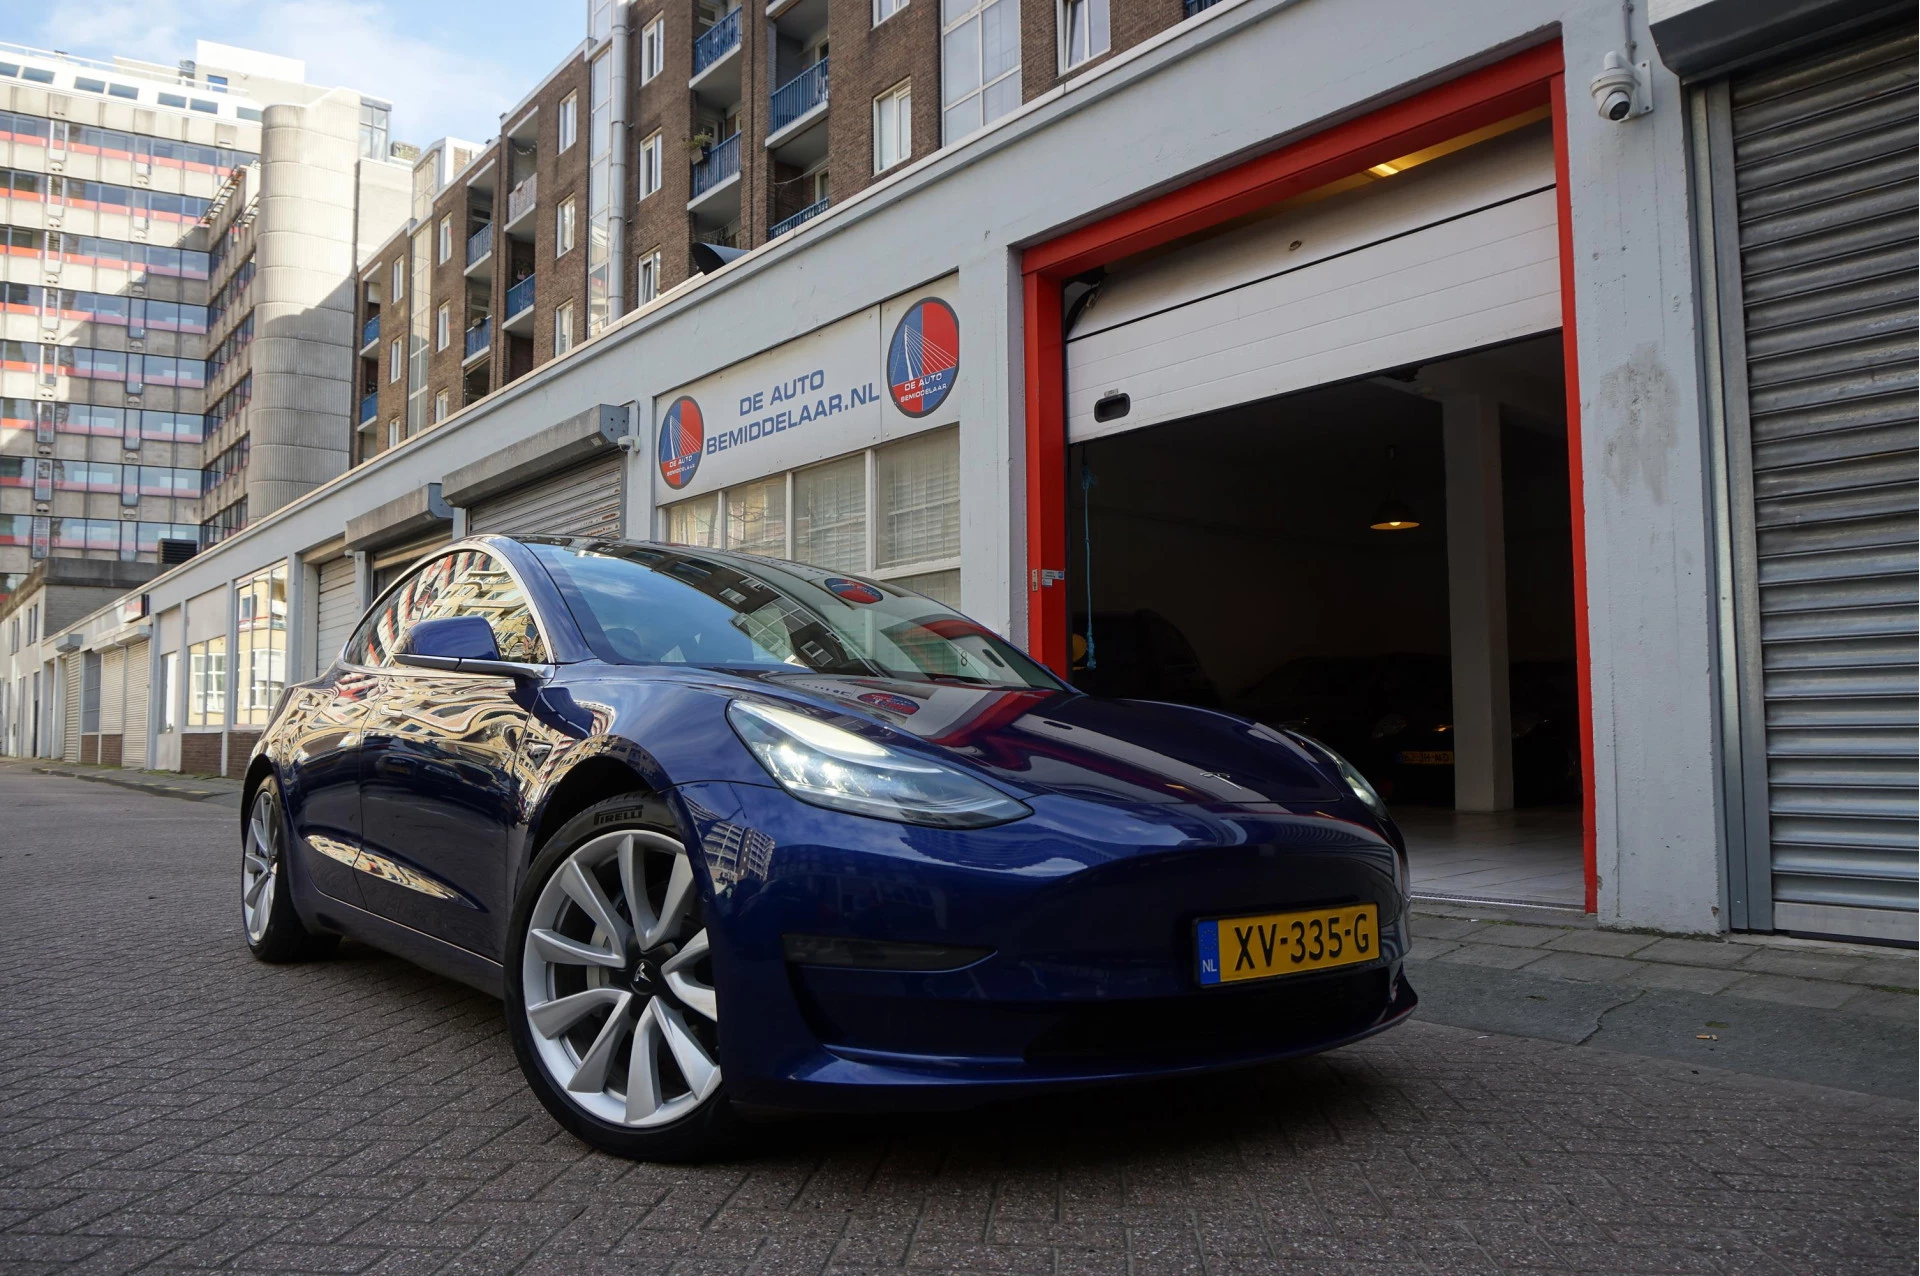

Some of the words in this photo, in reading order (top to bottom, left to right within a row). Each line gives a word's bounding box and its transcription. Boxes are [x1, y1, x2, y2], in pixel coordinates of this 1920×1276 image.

[739, 391, 764, 416] DE
[769, 369, 825, 406] AUTO
[904, 381, 916, 392] DE
[918, 373, 942, 386] AUTO
[900, 383, 948, 403] BEMIDDELAAR
[706, 382, 880, 455] BEMIDDELAAR.NL
[669, 460, 677, 468] DE
[678, 455, 693, 465] AUTO
[1234, 913, 1369, 971] XV-335-G
[1202, 958, 1217, 973] NL
